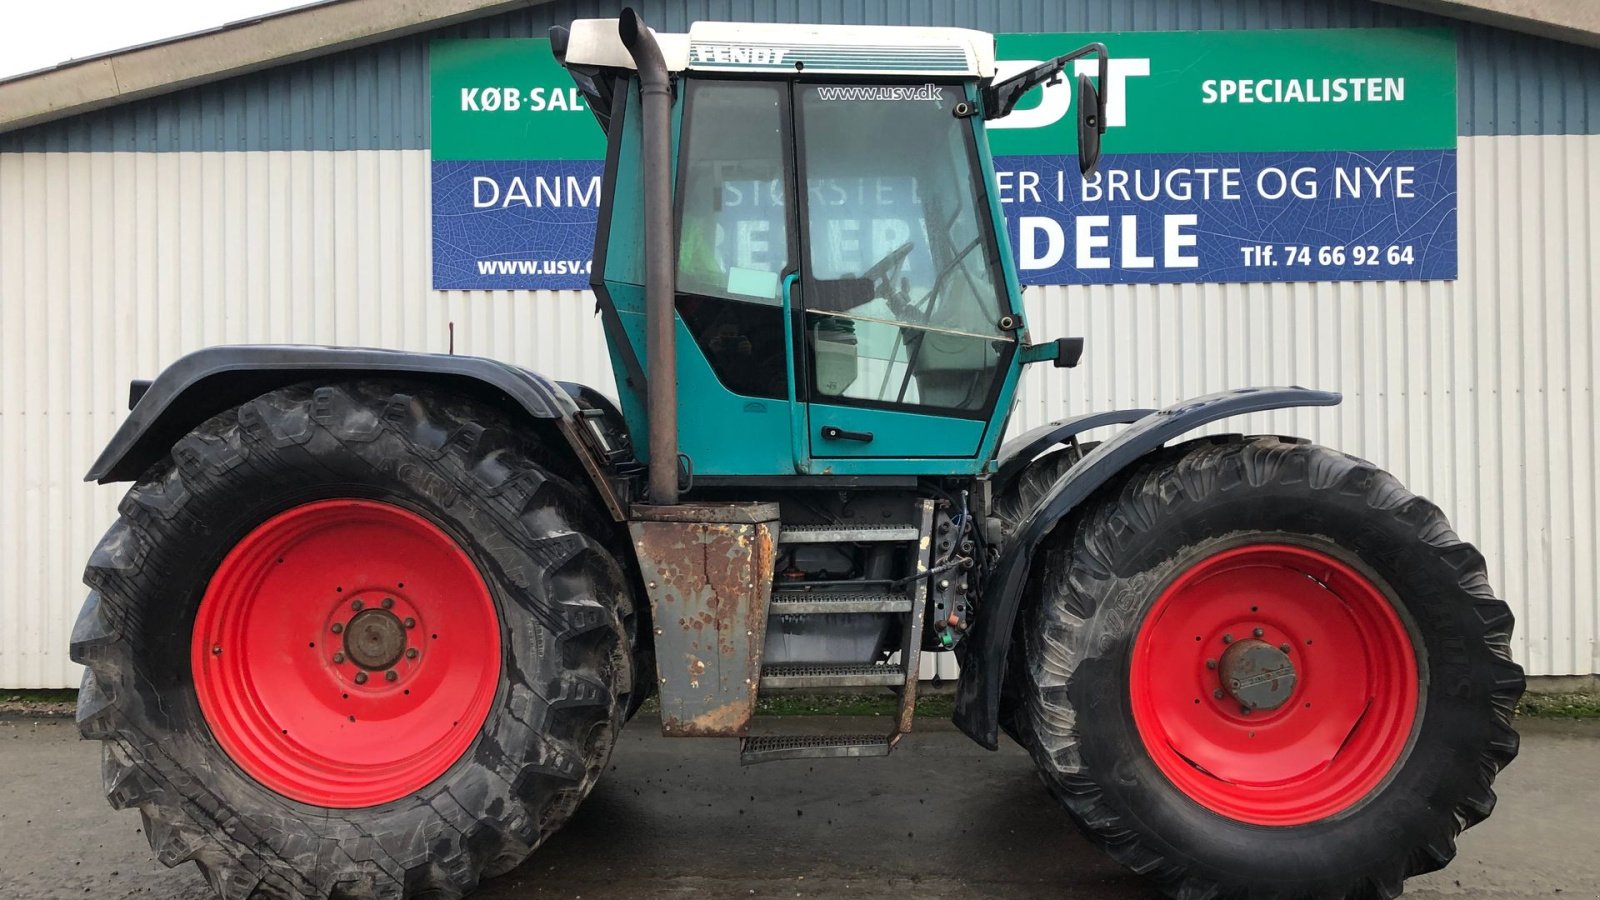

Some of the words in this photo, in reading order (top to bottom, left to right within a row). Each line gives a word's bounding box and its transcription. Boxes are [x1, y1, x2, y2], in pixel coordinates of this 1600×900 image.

[694, 46, 788, 63] FENDT
[461, 87, 590, 112] KØB·SAL
[818, 83, 943, 101] www.usv.dk
[1202, 78, 1405, 103] SPECIALISTEN
[473, 176, 601, 208] DANM
[1057, 170, 1064, 202] I
[1081, 168, 1241, 202] BRUGTE
[1256, 167, 1317, 200] OG
[1335, 166, 1415, 198] NYE
[1241, 246, 1278, 266] Tlf.
[1284, 246, 1311, 266] 74
[1318, 246, 1346, 266] 66
[1352, 246, 1379, 266] 92
[1387, 246, 1414, 265] 64
[477, 260, 592, 275] www.usv.
